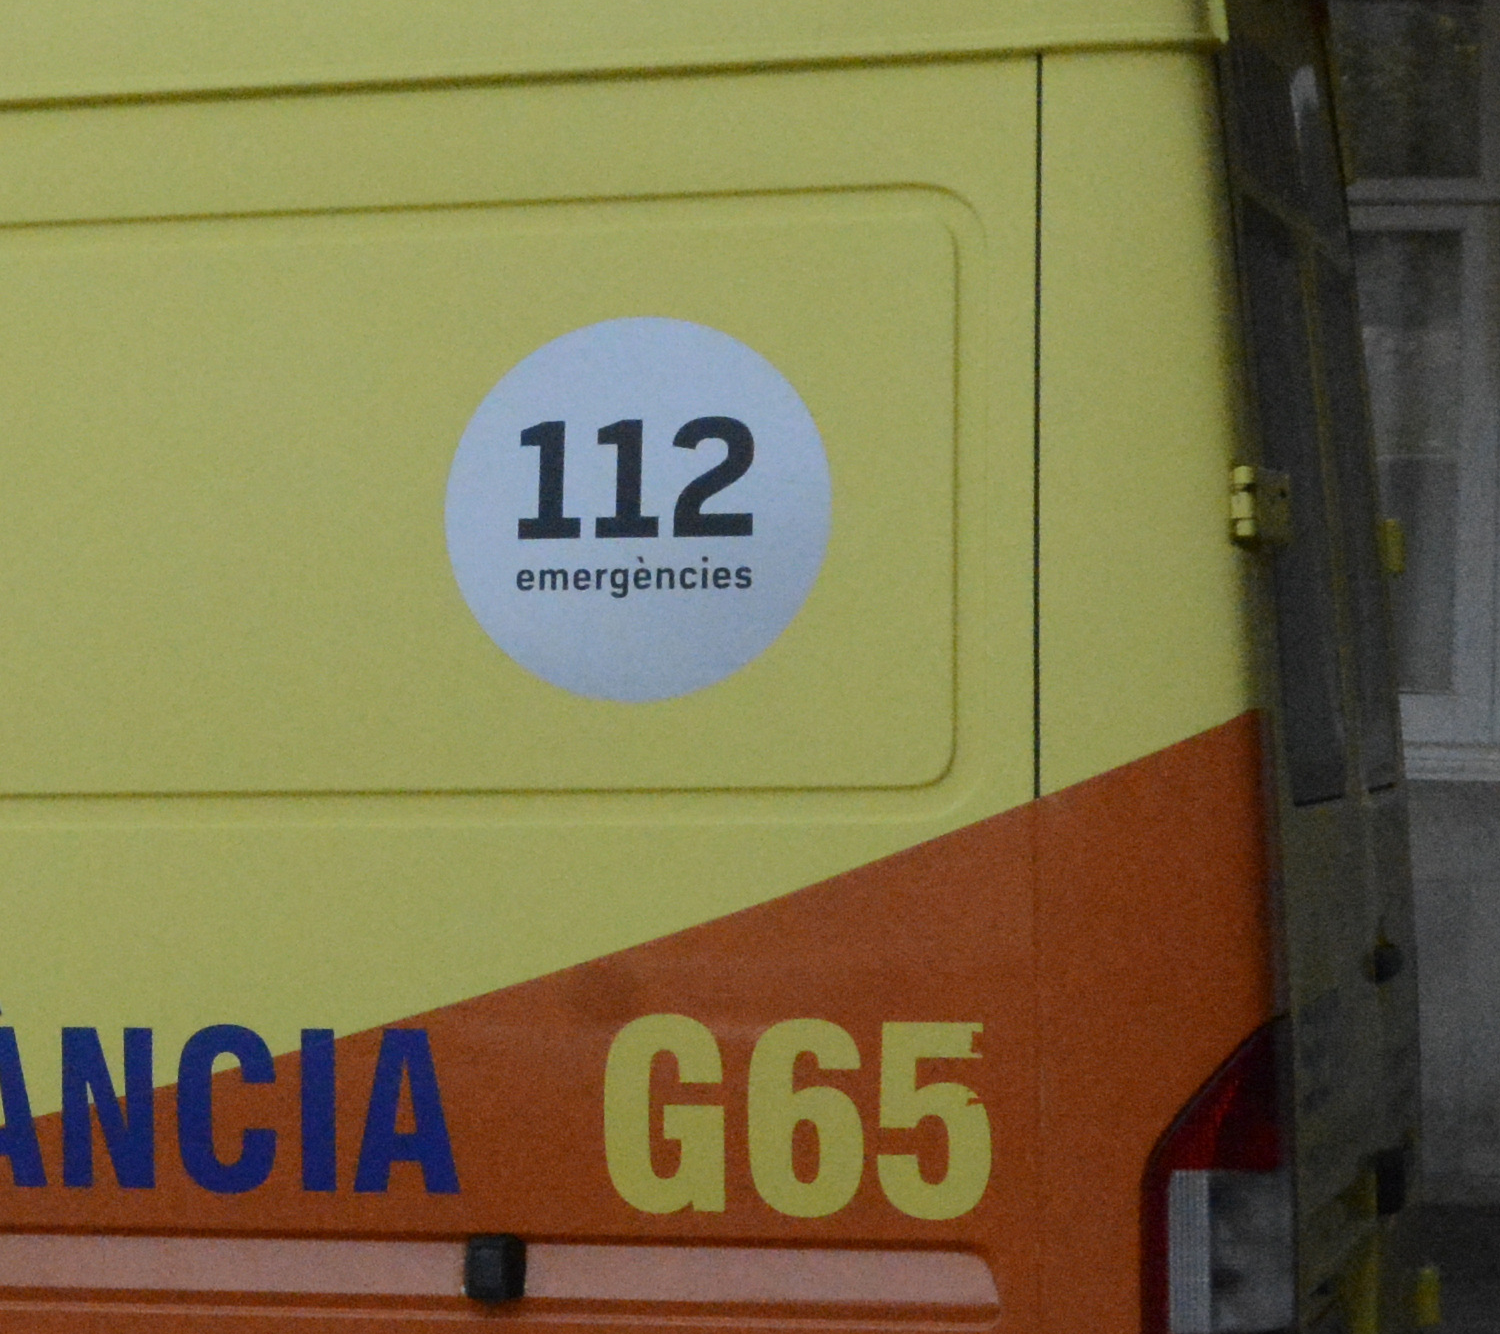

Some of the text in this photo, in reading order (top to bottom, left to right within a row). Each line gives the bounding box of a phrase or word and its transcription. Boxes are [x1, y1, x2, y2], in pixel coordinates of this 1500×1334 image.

[517, 415, 755, 540] 112
[515, 555, 753, 599] emergències
[602, 1012, 994, 1220] G65
